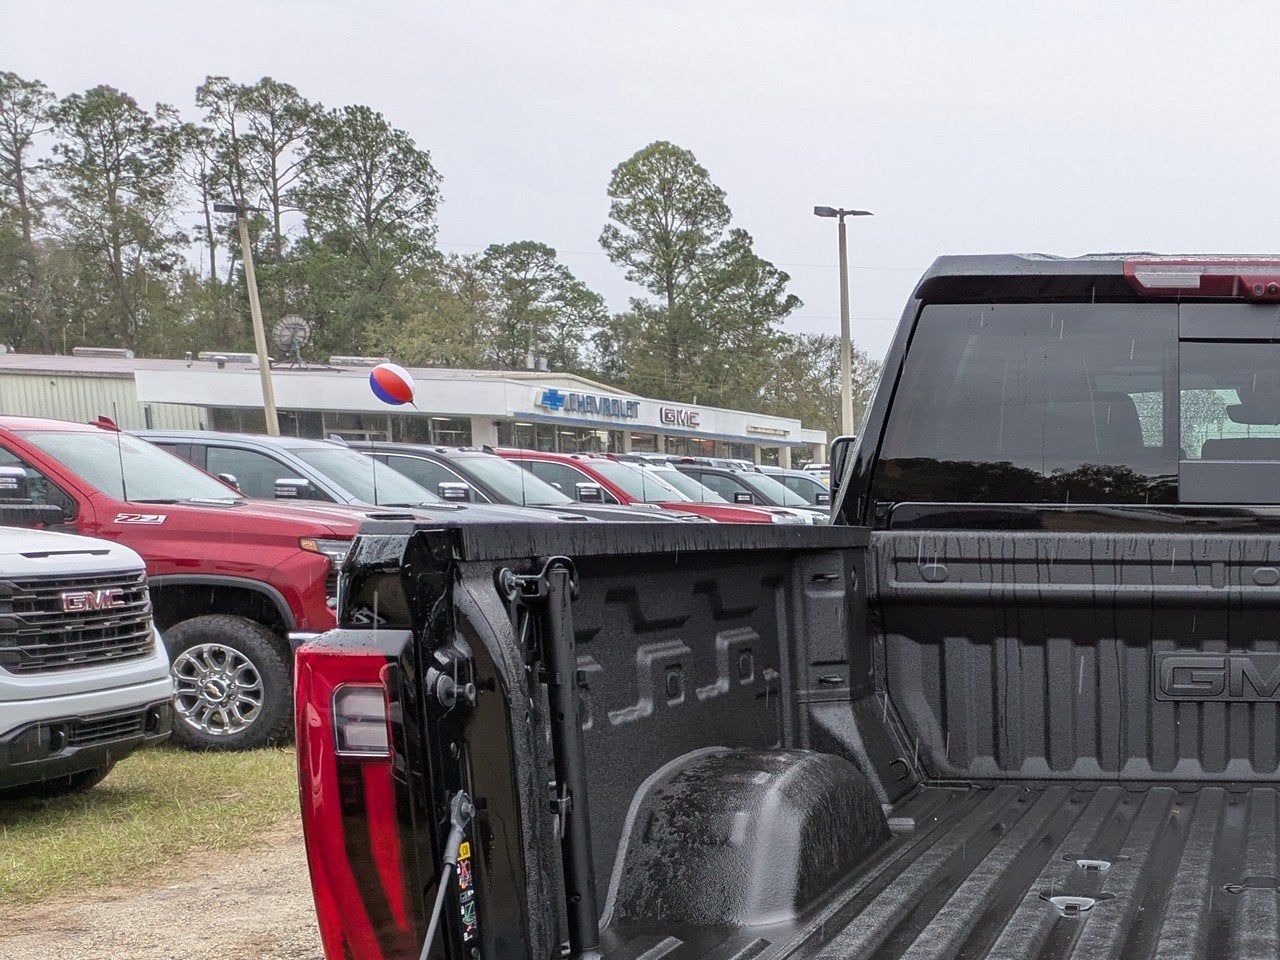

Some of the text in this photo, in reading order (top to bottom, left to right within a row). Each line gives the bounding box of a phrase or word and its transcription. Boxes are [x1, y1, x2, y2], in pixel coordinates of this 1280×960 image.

[568, 393, 640, 418] CHEVROLET
[661, 407, 700, 428] GMC
[113, 513, 168, 525] Z71
[62, 589, 125, 612] GMC
